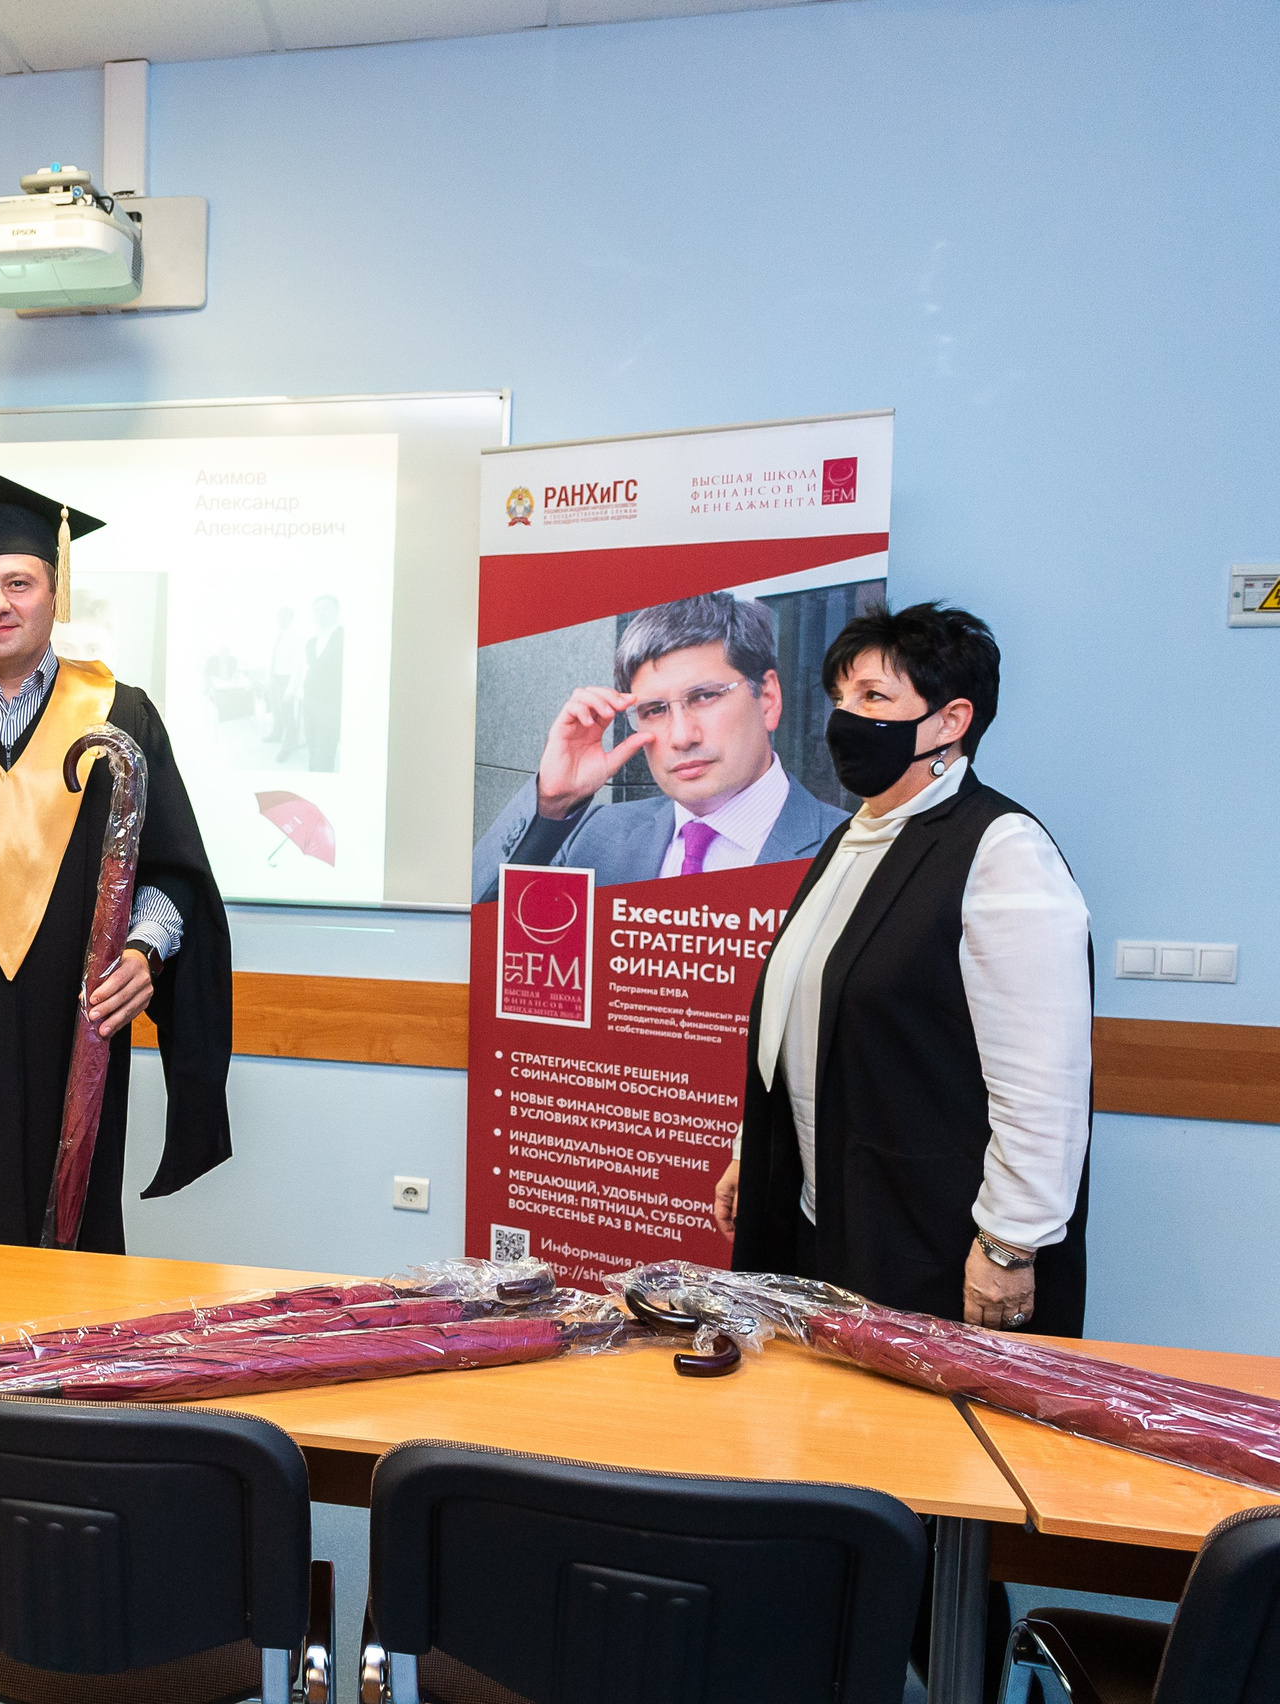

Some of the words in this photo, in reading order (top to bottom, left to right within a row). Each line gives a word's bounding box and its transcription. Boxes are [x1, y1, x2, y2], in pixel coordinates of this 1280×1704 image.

[195, 469, 267, 486] Акимов
[690, 485, 794, 500] ФИНАНСОВ
[807, 483, 817, 492] И
[692, 473, 753, 487] ВЫСШАЯ
[763, 469, 817, 481] ШКОЛА
[194, 494, 300, 514] Александр
[544, 479, 638, 508] РАНХиГС
[690, 497, 816, 513] МЕНЕДЖМЕНТА
[194, 520, 345, 540] Александрович
[612, 898, 741, 930] Executive
[609, 955, 735, 984] ФИНАНСЫ
[608, 982, 658, 996] Программа
[607, 1012, 678, 1028] руководителей,
[679, 1018, 737, 1033] финансовых
[615, 1024, 682, 1039] собственников
[684, 1031, 722, 1044] бизнеса
[510, 1051, 621, 1076] СТРАТЕГИЧЕСКИЕ
[624, 1065, 689, 1085] РЕШЕНИЯ
[510, 1066, 519, 1077] С
[520, 1068, 617, 1091] ФИНАНСОВЫМ
[619, 1081, 738, 1107] ОБОСНОВАНИЕМ
[510, 1090, 554, 1107] НОВЫЕ
[556, 1097, 650, 1121] ФИНАНСОВЫЕ
[510, 1105, 518, 1116] В
[520, 1107, 588, 1127] УСЛОВИЯХ
[590, 1118, 652, 1138] КРИЗИСА
[655, 1127, 666, 1140] И
[509, 1129, 634, 1160] ИНДИВИДУАЛЬНОЕ
[636, 1150, 710, 1172] ОБУЧЕНИЕ
[509, 1144, 519, 1156] И
[521, 1146, 660, 1180] КОНСУЛЬТИРОВАНИЕ
[509, 1168, 600, 1197] МЕРЦАЮЩИЙ,
[601, 1185, 669, 1207] УДОБНЫЙ
[671, 1197, 715, 1215] ФОРМ
[508, 1183, 579, 1206] ОБУЧЕНИЯ:
[581, 1196, 649, 1220] ПЯТНИЦА,
[650, 1209, 717, 1233] СУББОТА,
[508, 1198, 595, 1224] ВОСКРЕСЕНЬЕ
[598, 1215, 622, 1229] РАЗ
[624, 1220, 632, 1232] В
[635, 1222, 682, 1242] МЕСЯЦ
[540, 1237, 632, 1268] Информация
